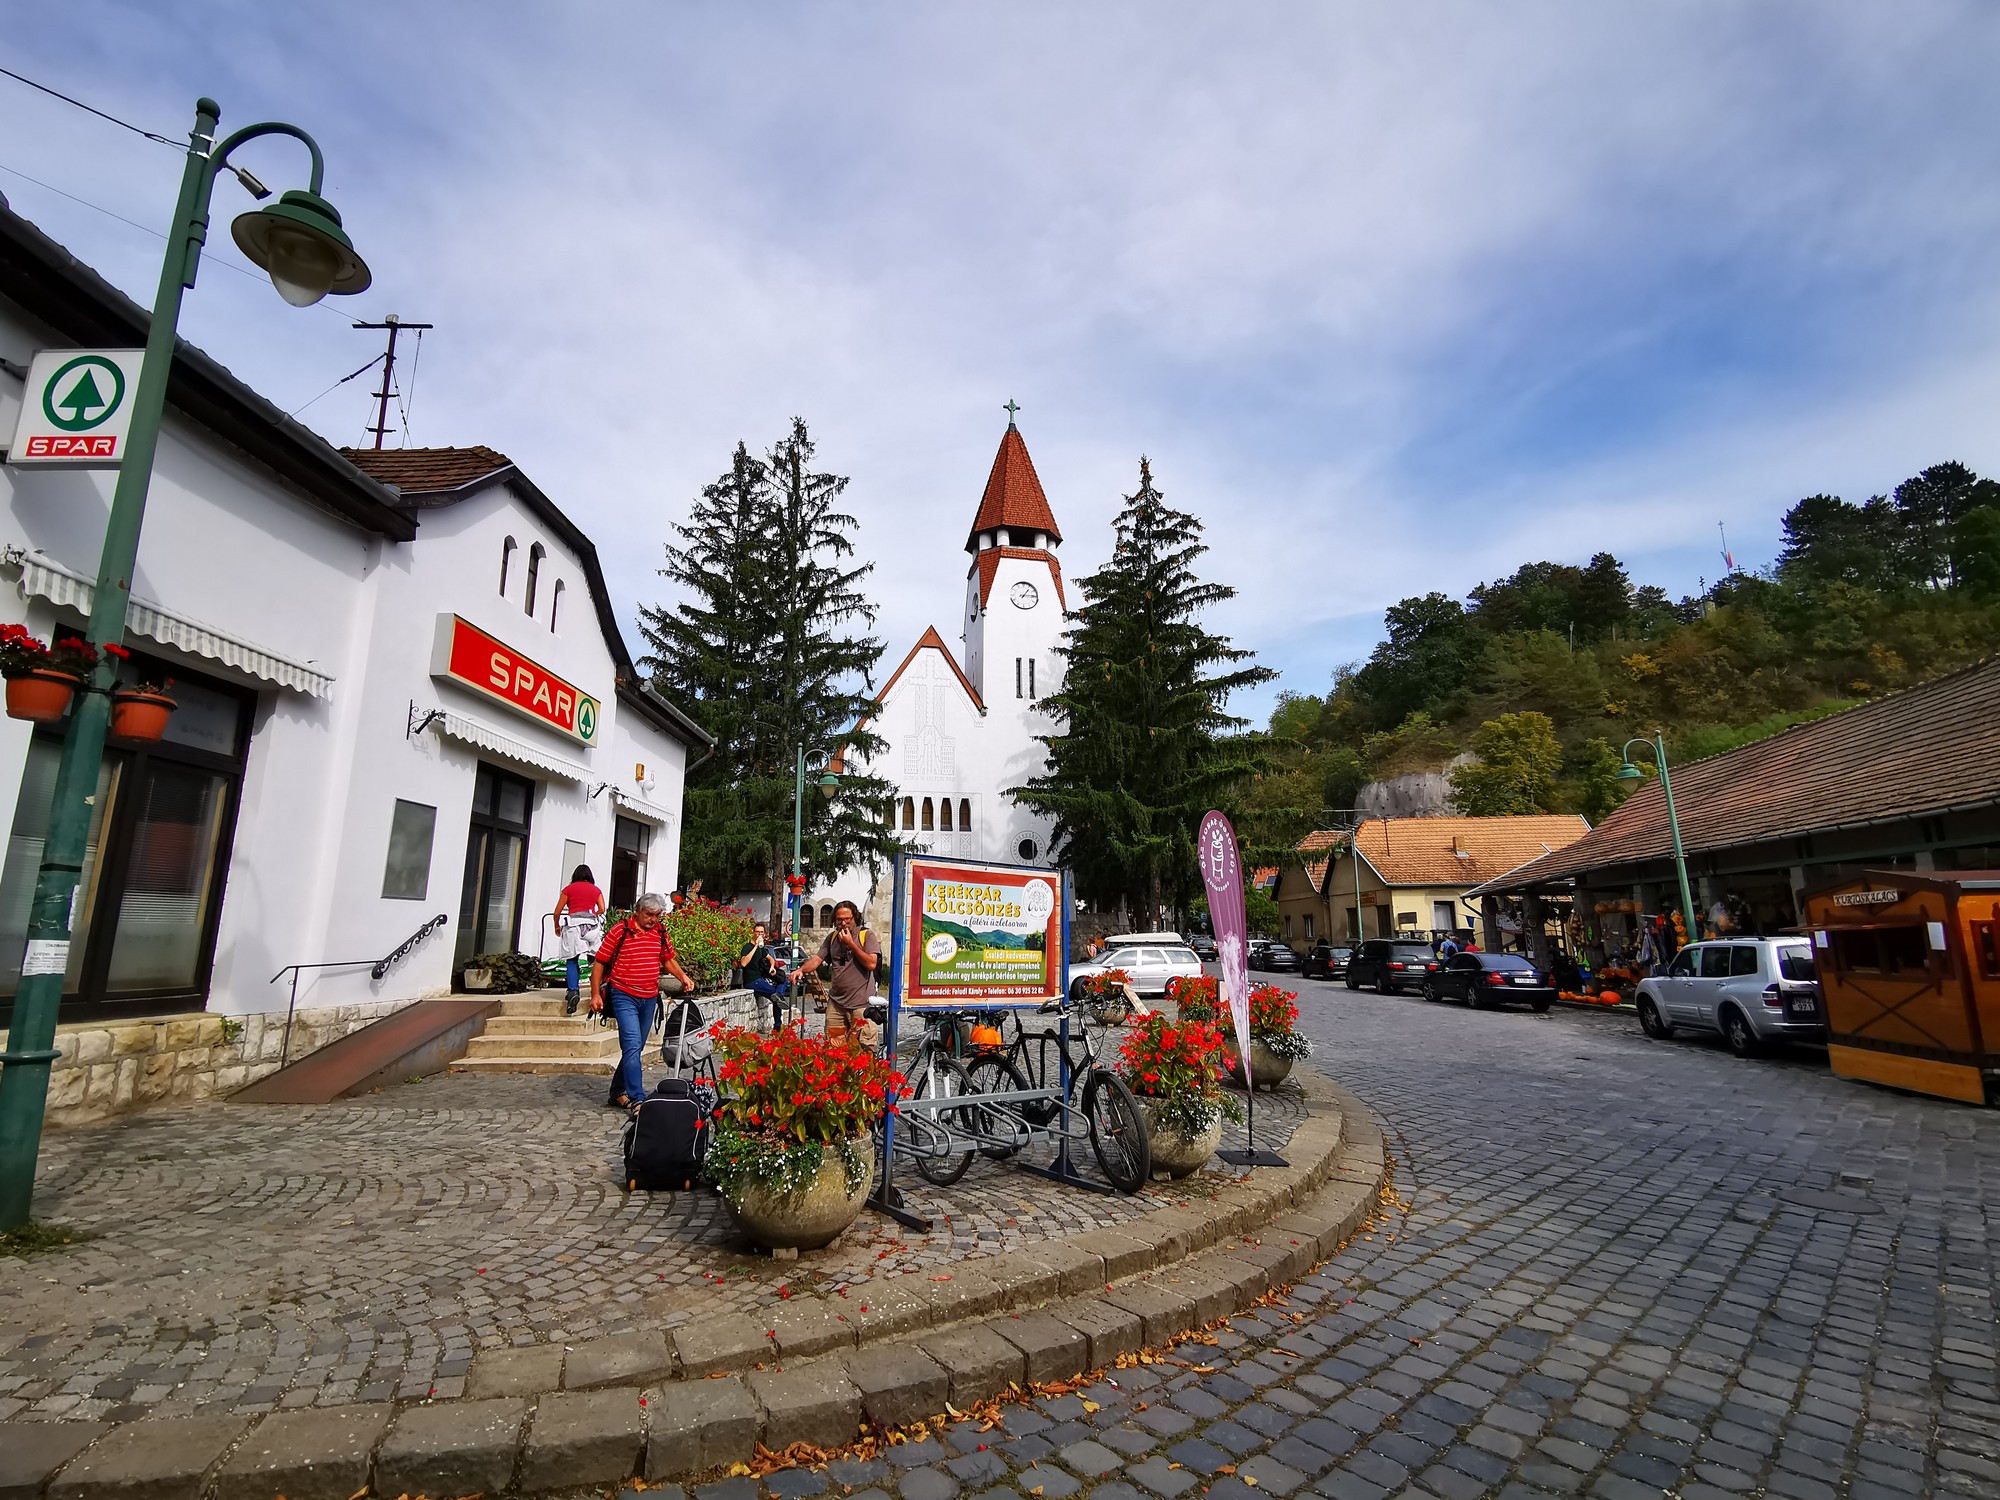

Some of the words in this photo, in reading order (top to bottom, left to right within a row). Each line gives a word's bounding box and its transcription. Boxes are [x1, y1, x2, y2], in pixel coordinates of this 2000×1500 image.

[30, 439, 112, 454] SPAR
[489, 652, 573, 724] SPAR
[928, 884, 1002, 901] KERÉKPÁR
[926, 897, 1021, 918] KÖLCSÖNZÉS
[990, 918, 1028, 928] üzletsoron
[932, 938, 948, 949] Napi
[932, 946, 953, 960] ajánlat
[956, 961, 976, 969] minden
[1008, 962, 1040, 971] gyermeknek
[928, 971, 960, 979] szülőnként
[961, 973, 970, 981] egy
[971, 971, 995, 981] kerékpár
[968, 988, 983, 996] Károly
